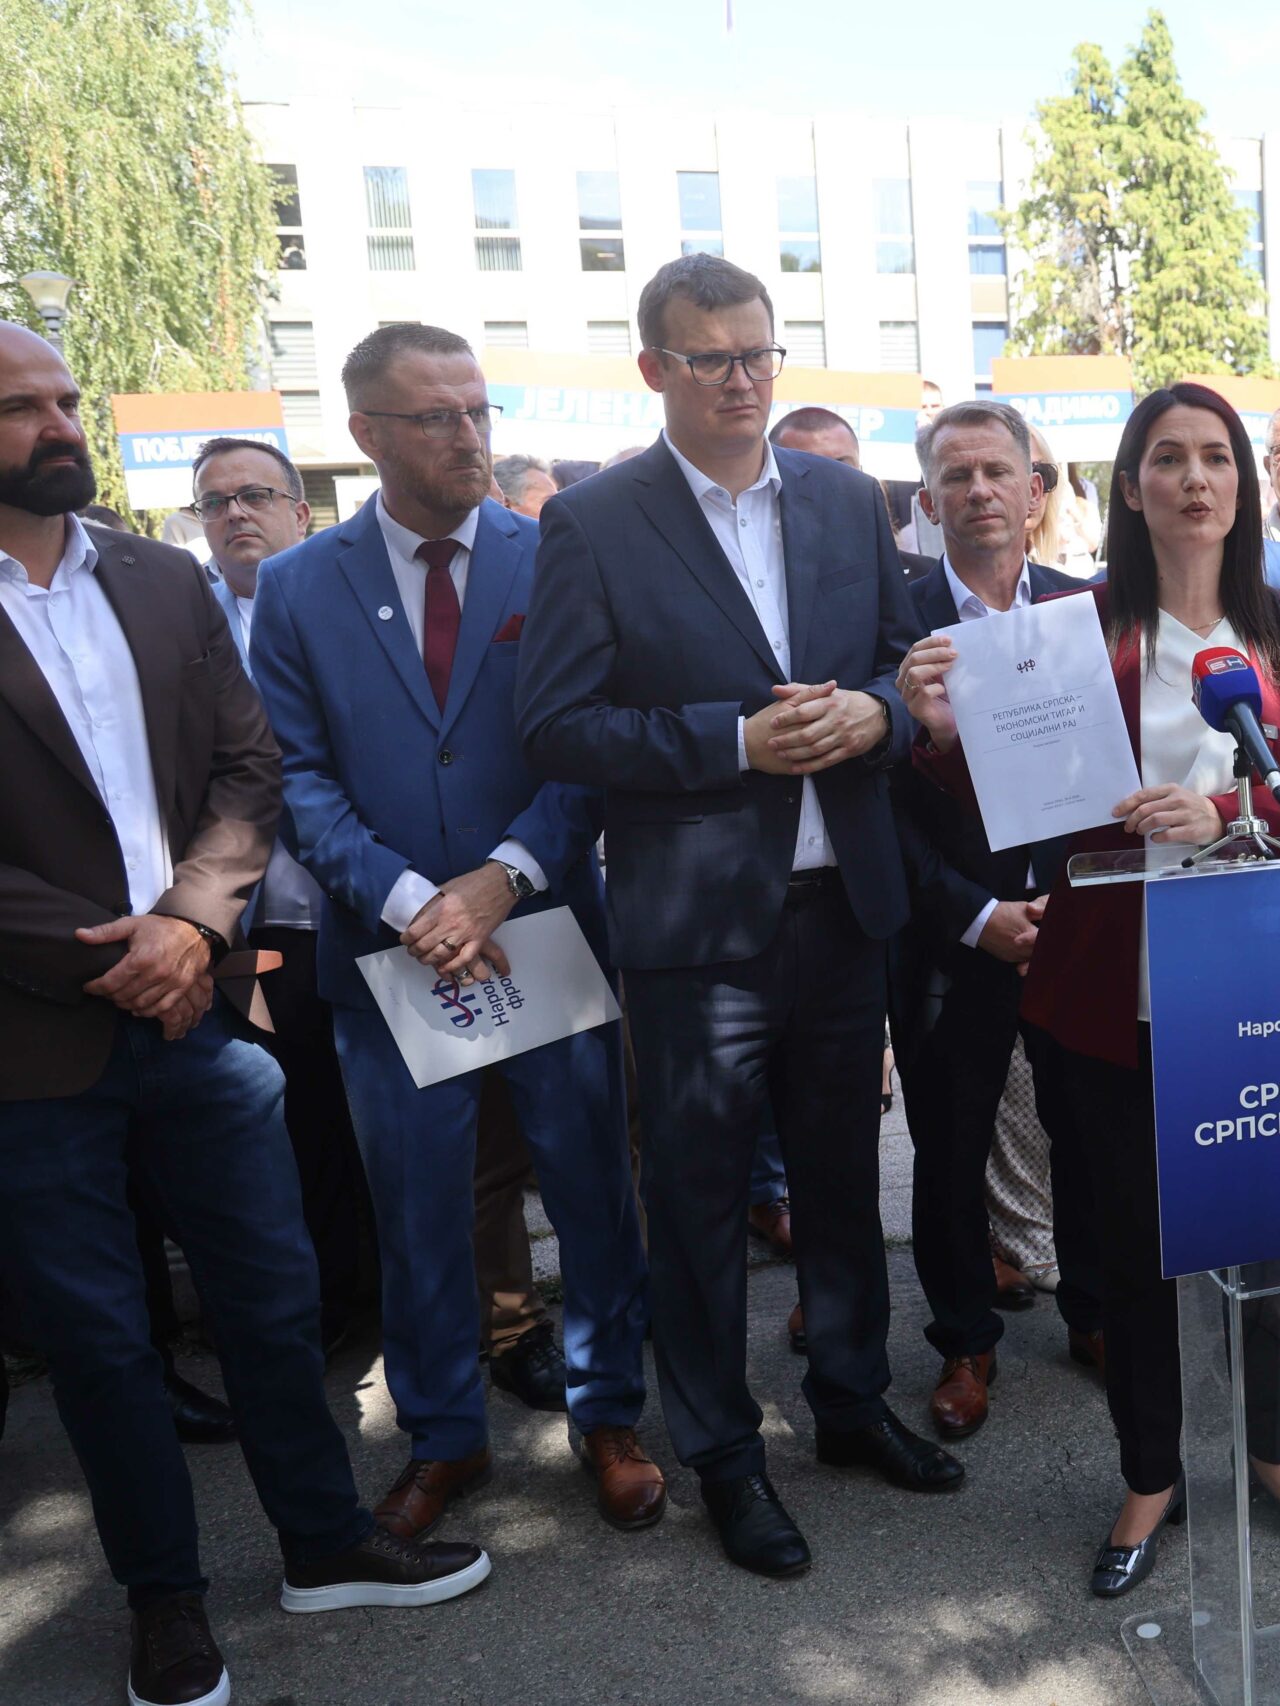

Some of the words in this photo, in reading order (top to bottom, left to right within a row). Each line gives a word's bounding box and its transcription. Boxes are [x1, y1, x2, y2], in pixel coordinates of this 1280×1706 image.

[992, 703, 1041, 721] РЕПУБЛИКА
[1042, 694, 1076, 709] СРПСКА
[996, 713, 1050, 733] ЕКОНОМСКИ
[1051, 705, 1077, 720] ТИГАР
[1078, 704, 1085, 713] И
[1010, 723, 1061, 742] СОЦИЈАЛНИ
[1063, 719, 1077, 729] РАЈ
